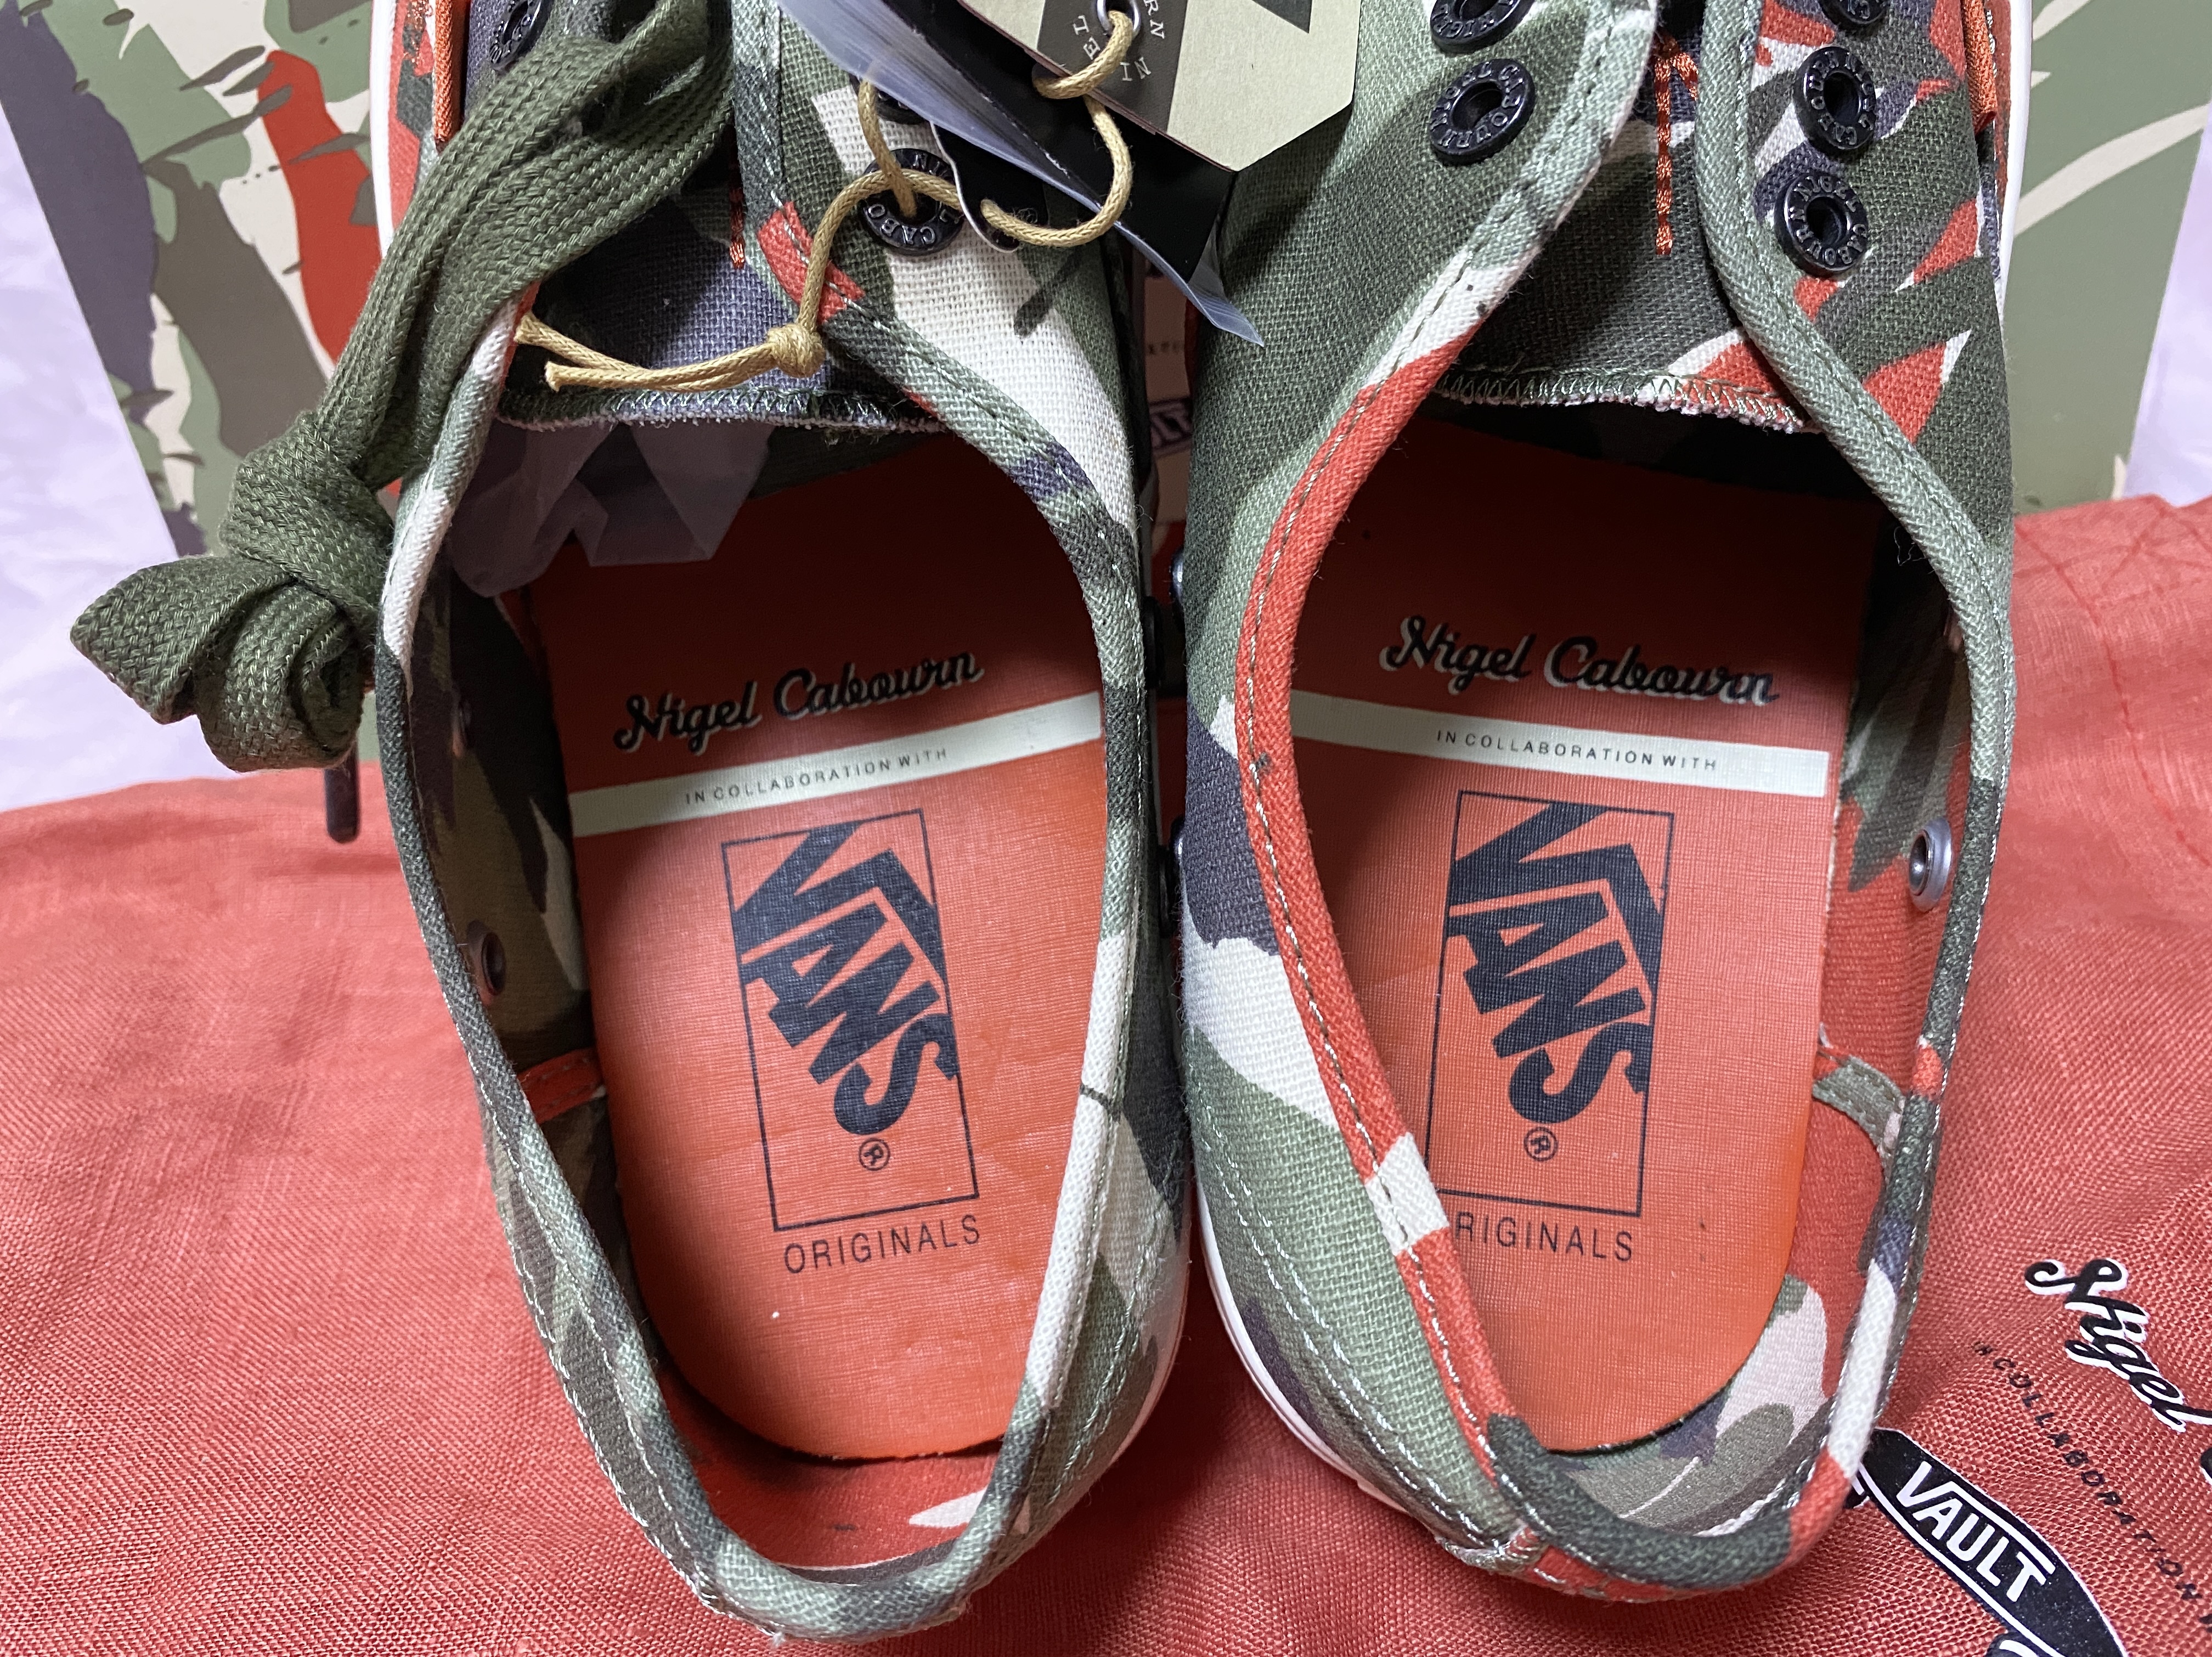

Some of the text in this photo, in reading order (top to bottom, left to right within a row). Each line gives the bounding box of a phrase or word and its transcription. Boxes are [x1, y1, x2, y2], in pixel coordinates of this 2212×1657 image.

[1789, 176, 1867, 266] NIGEL CABOURN
[613, 651, 984, 756] Nigel Cabourn
[1379, 615, 1780, 706] Nigel Cabourn
[684, 748, 949, 805] IN COLLABORATION WITH
[1436, 729, 1718, 771] IN COLLABORATION WITH
[734, 821, 958, 1136] VANS
[1447, 802, 1661, 1124] VANS
[783, 1214, 981, 1274] ORIGINALS
[1455, 1211, 1634, 1262] RIGINALS
[2024, 1259, 2212, 1432] Nigel
[1896, 1461, 2056, 1602] VAULT
